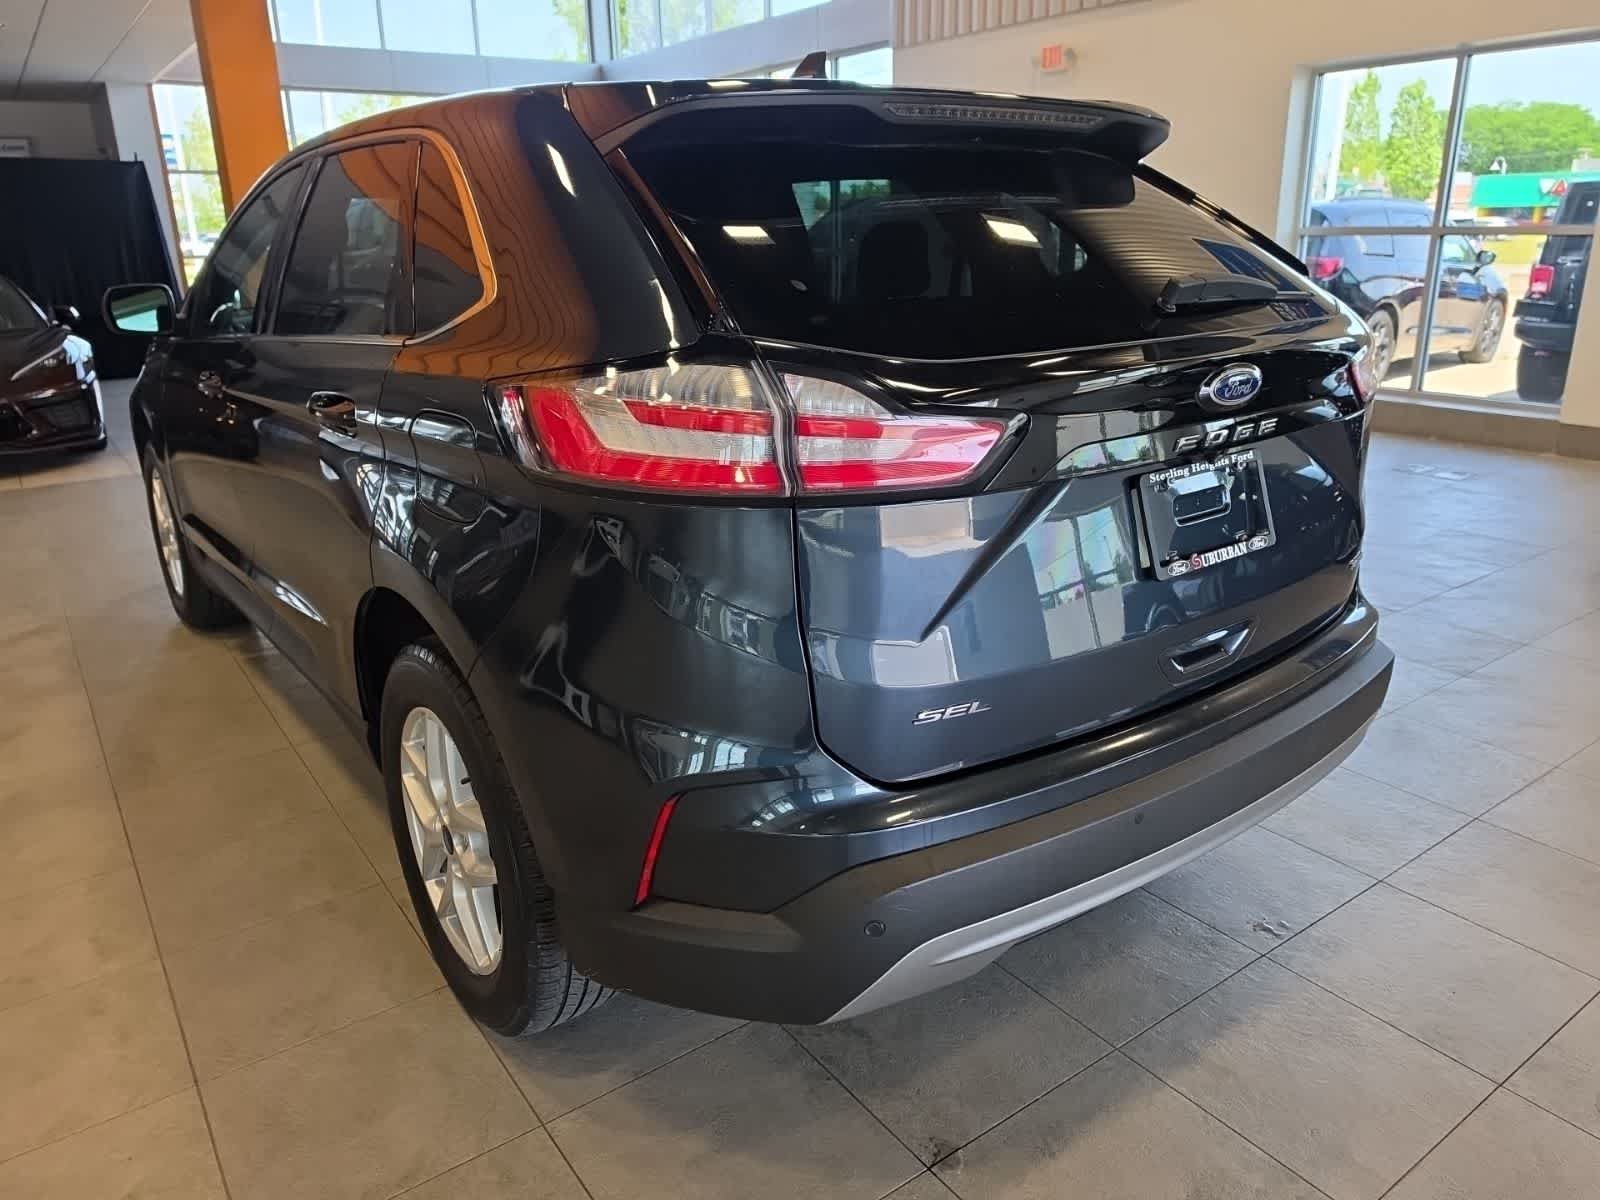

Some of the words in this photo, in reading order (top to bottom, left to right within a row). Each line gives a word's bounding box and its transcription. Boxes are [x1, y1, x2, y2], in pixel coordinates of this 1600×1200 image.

[1222, 374, 1253, 398] Ford
[1175, 418, 1279, 452] EDGE
[1149, 467, 1190, 483] Sterling
[1231, 450, 1254, 463] Ford
[1191, 541, 1248, 569] SUBURBAN
[912, 701, 992, 725] SEL
